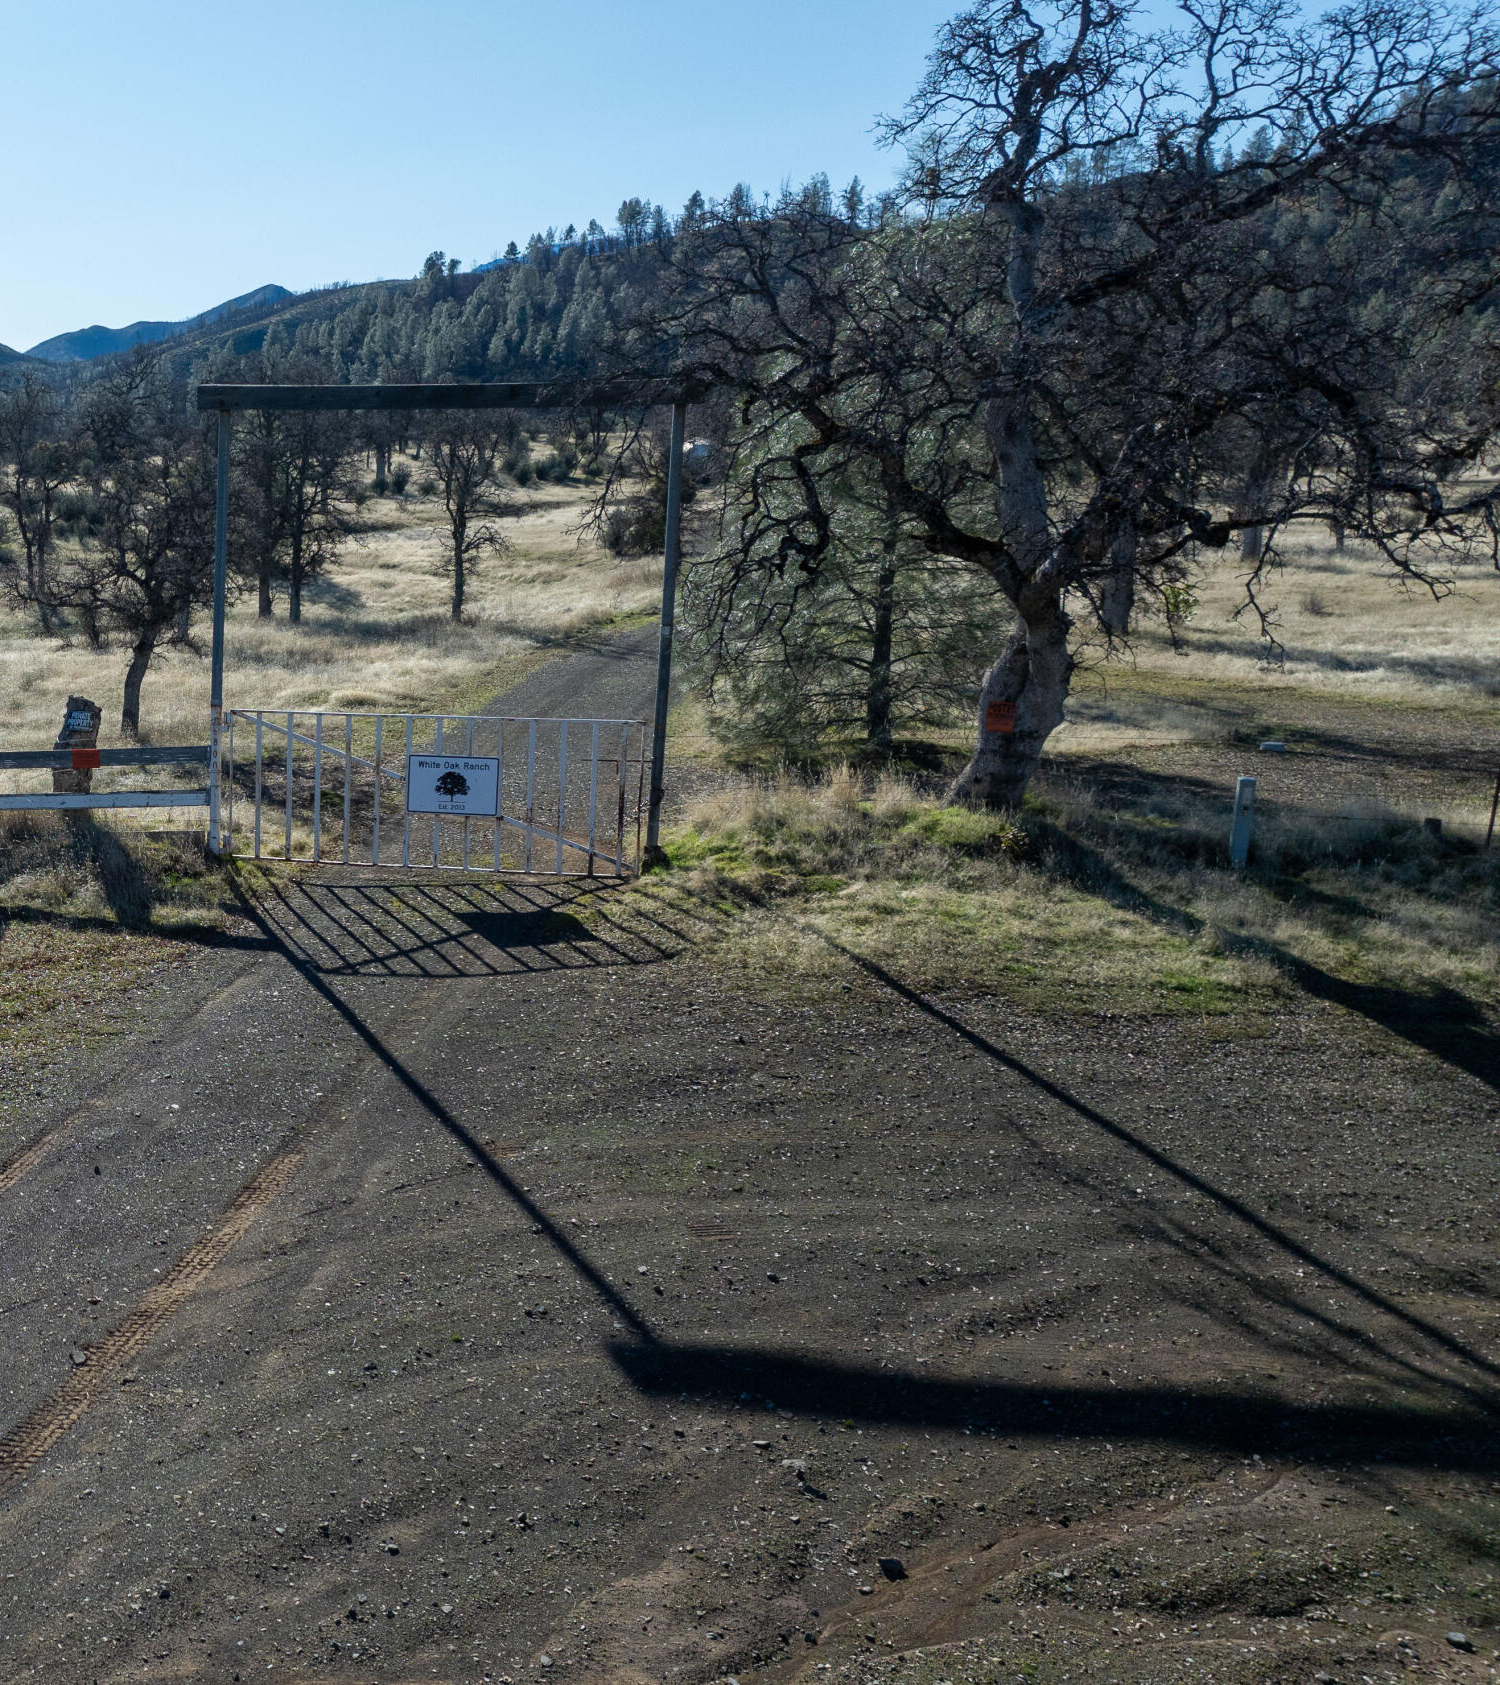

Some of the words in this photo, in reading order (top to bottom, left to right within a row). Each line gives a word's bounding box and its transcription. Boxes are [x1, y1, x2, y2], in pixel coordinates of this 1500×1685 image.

[419, 761, 441, 769] White
[443, 761, 460, 769] Oak
[463, 762, 490, 770] Ranch
